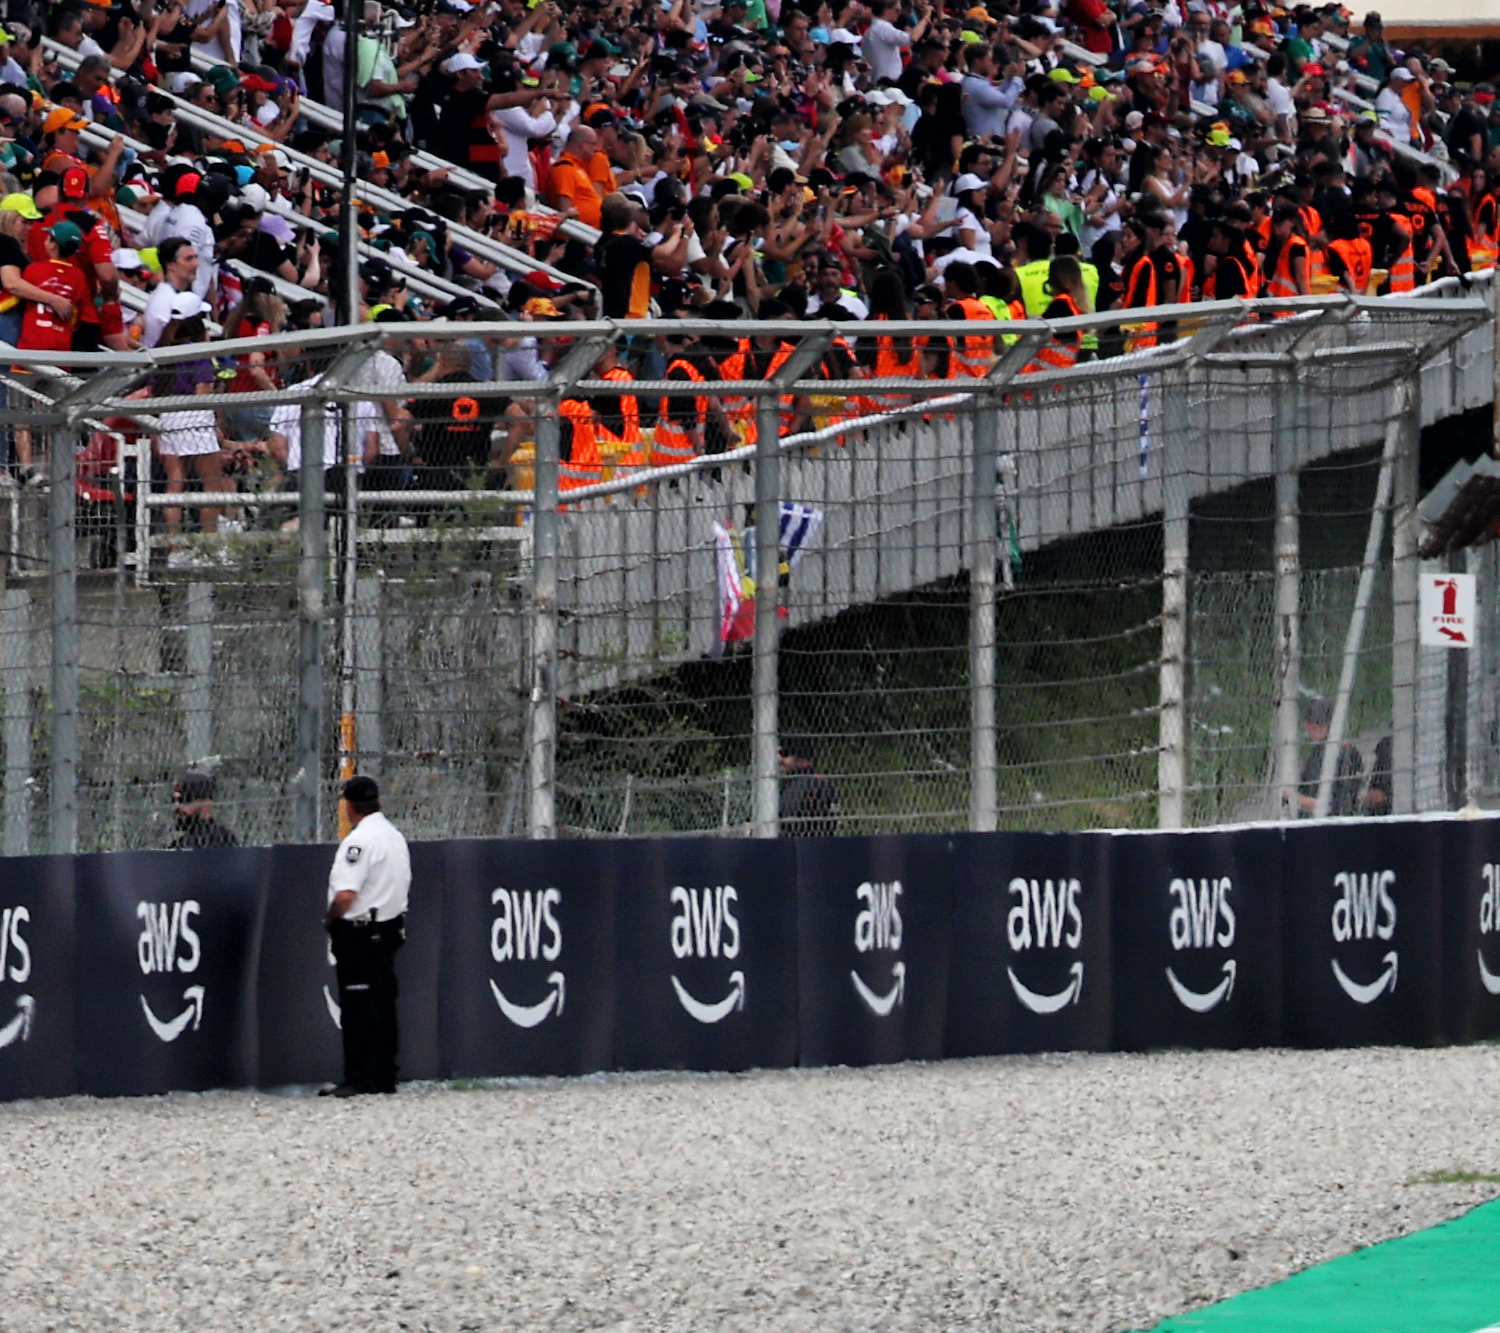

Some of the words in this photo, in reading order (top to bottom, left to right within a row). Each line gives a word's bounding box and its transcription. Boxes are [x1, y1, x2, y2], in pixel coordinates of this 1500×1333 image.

[1432, 616, 1465, 624] FIRE
[137, 900, 200, 974] aws
[491, 888, 561, 961] aws
[671, 886, 739, 959] aws
[855, 881, 902, 952] aws
[1007, 878, 1082, 951] aws
[1169, 877, 1235, 950] aws
[1332, 870, 1396, 942] aws
